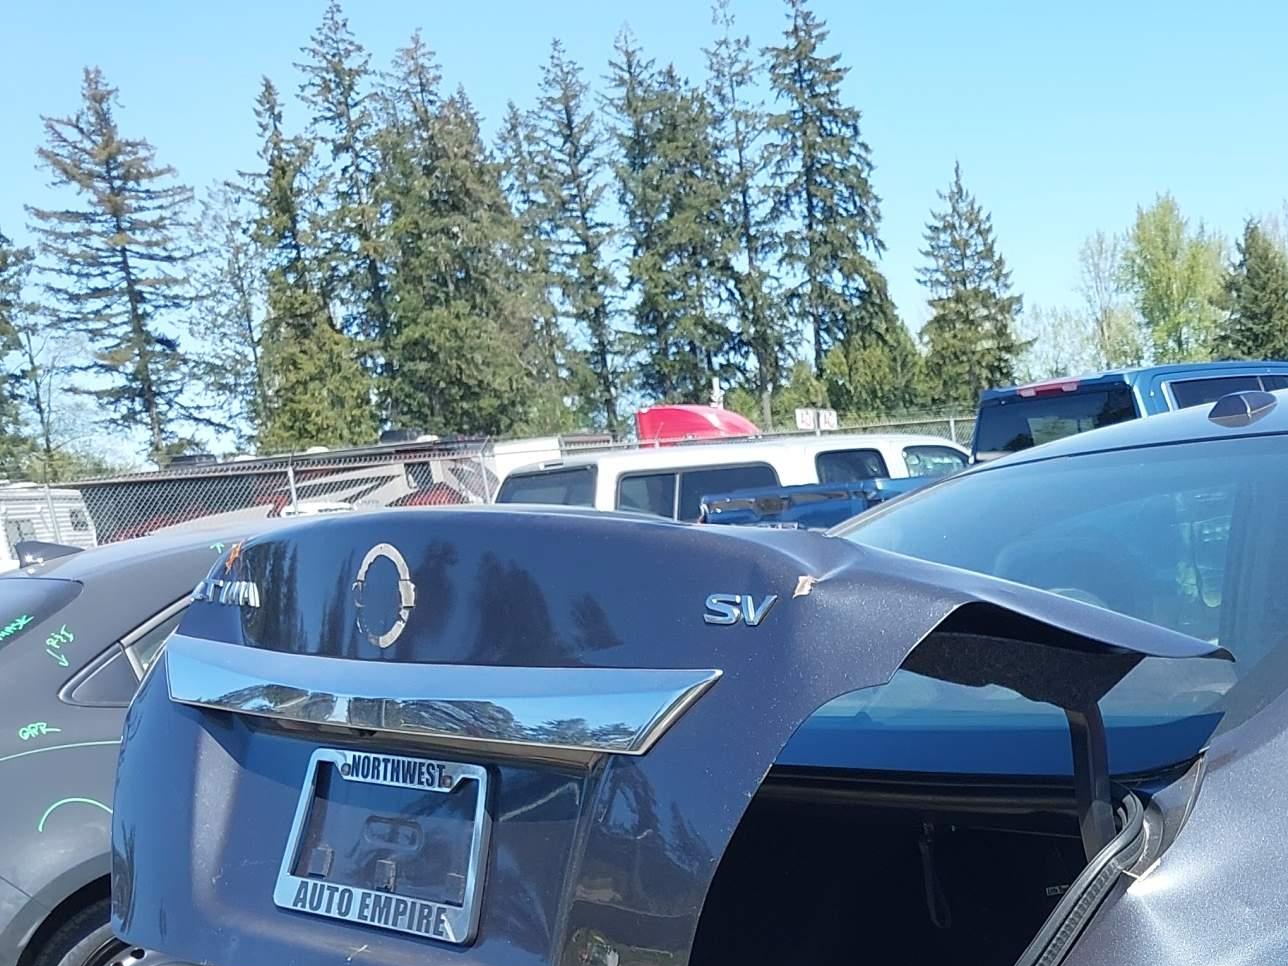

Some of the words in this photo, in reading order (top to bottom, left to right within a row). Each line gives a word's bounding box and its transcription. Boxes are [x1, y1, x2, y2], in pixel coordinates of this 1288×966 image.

[703, 593, 778, 626] SV
[350, 754, 447, 788] NORTHWEST
[292, 880, 354, 918] AUTO
[357, 891, 448, 937] EMPIRE
